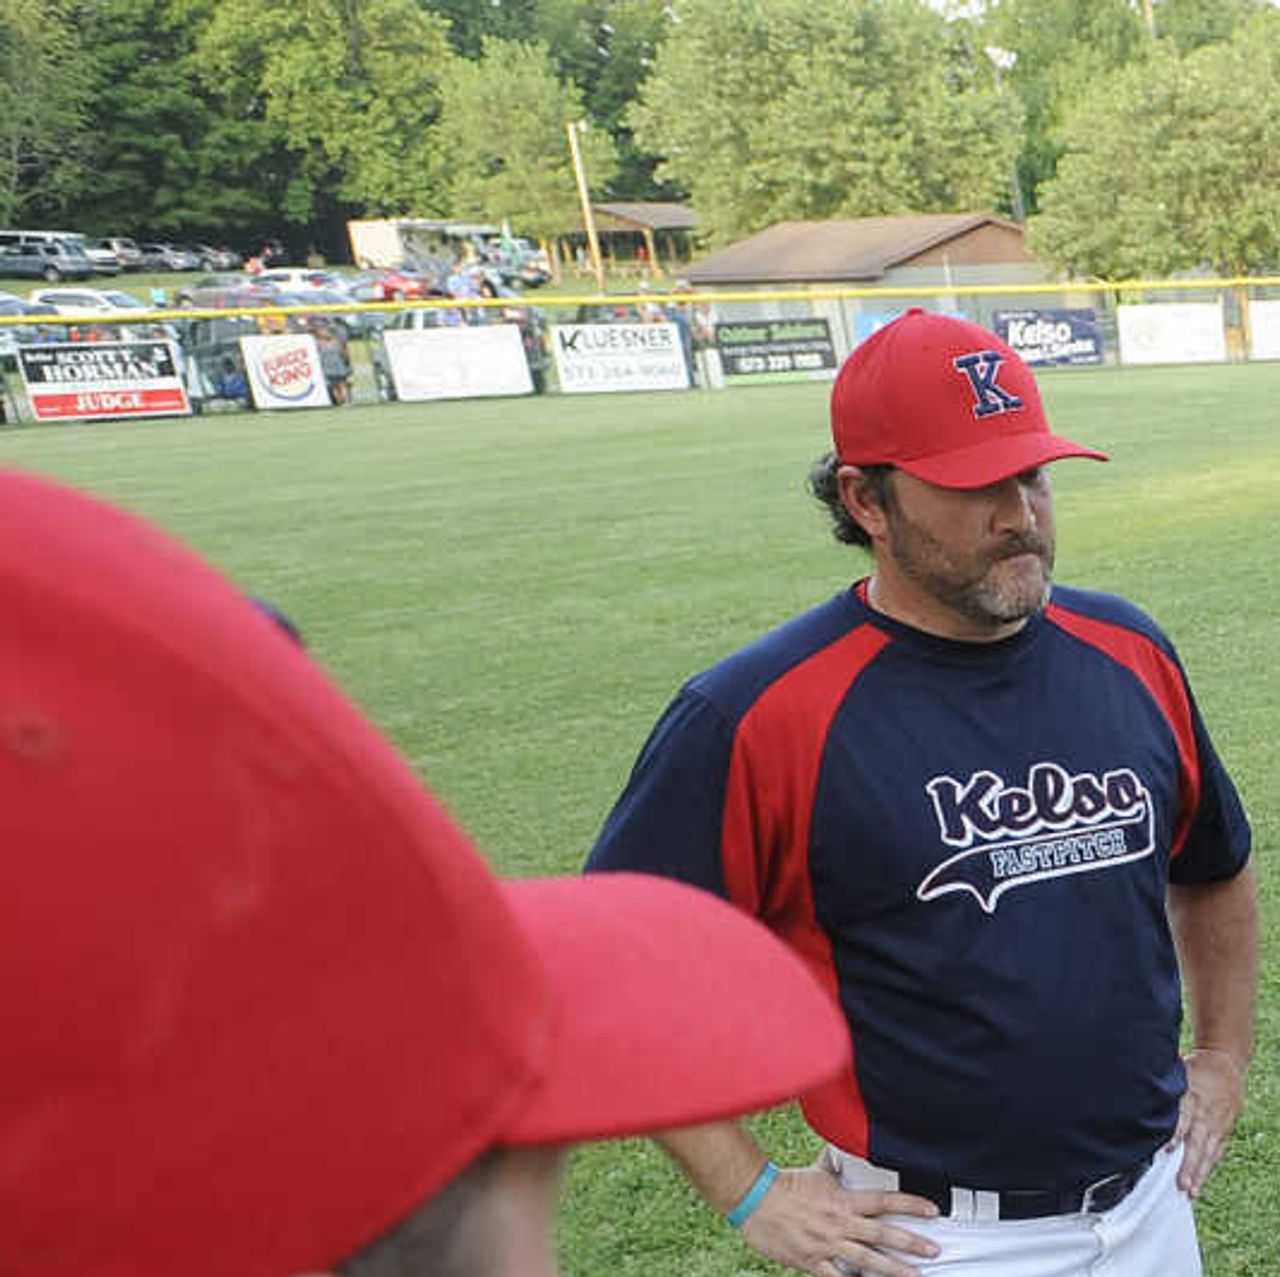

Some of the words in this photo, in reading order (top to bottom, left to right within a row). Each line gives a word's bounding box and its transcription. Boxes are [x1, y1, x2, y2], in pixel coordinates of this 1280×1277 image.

[559, 327, 673, 352] KLUESNER
[1007, 319, 1072, 346] Kelso
[75, 393, 143, 412] JUDGE
[953, 350, 1024, 419] K
[926, 762, 1148, 847] Kelso
[990, 828, 1127, 878] FASTPITCH
